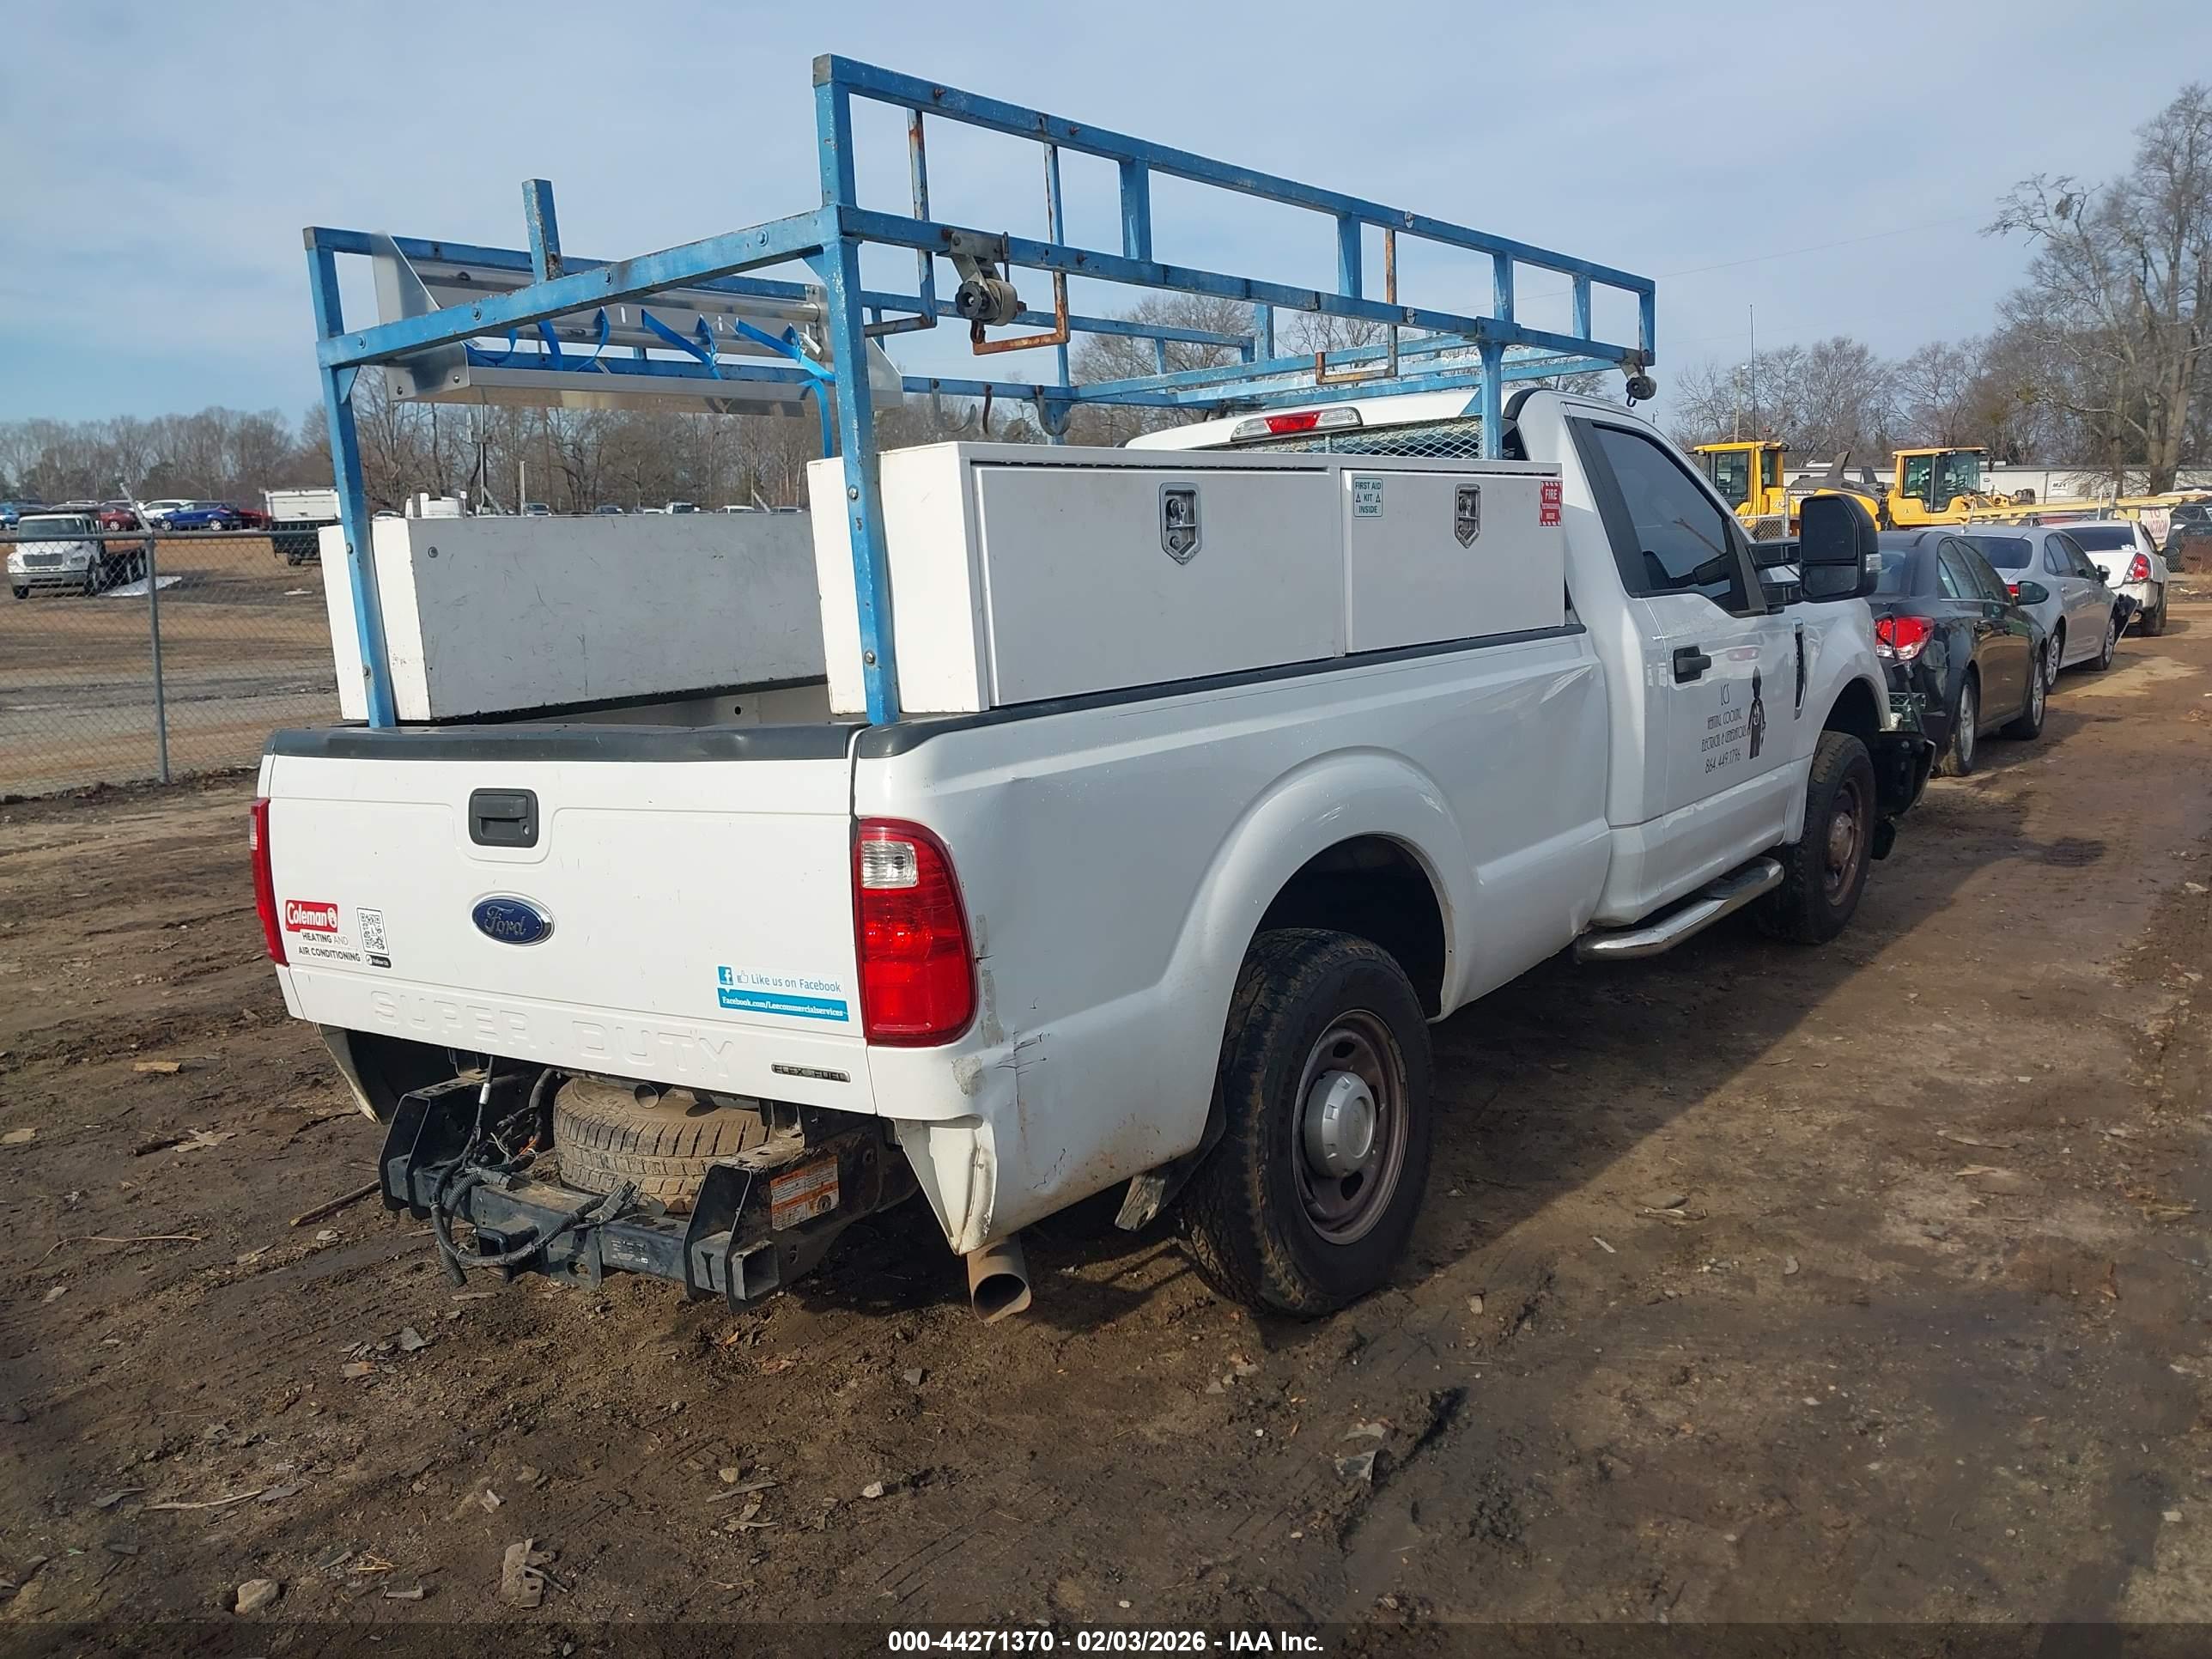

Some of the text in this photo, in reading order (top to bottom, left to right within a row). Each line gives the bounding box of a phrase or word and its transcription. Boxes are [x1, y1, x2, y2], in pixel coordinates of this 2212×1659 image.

[1354, 481, 1382, 490] FIRST AID
[1364, 493, 1373, 503] KIT
[1545, 489, 1558, 501] FIRE
[1358, 505, 1378, 514] INSIDE
[287, 902, 328, 927] Coleman
[483, 904, 526, 938] Ford
[301, 932, 349, 945] HEATING AND
[298, 945, 362, 963] AIR CONDITIONING
[750, 974, 842, 993] Like us on Facebook
[370, 989, 735, 1079] SUPER DUTY
[775, 1065, 848, 1083] FLEX FUEL
